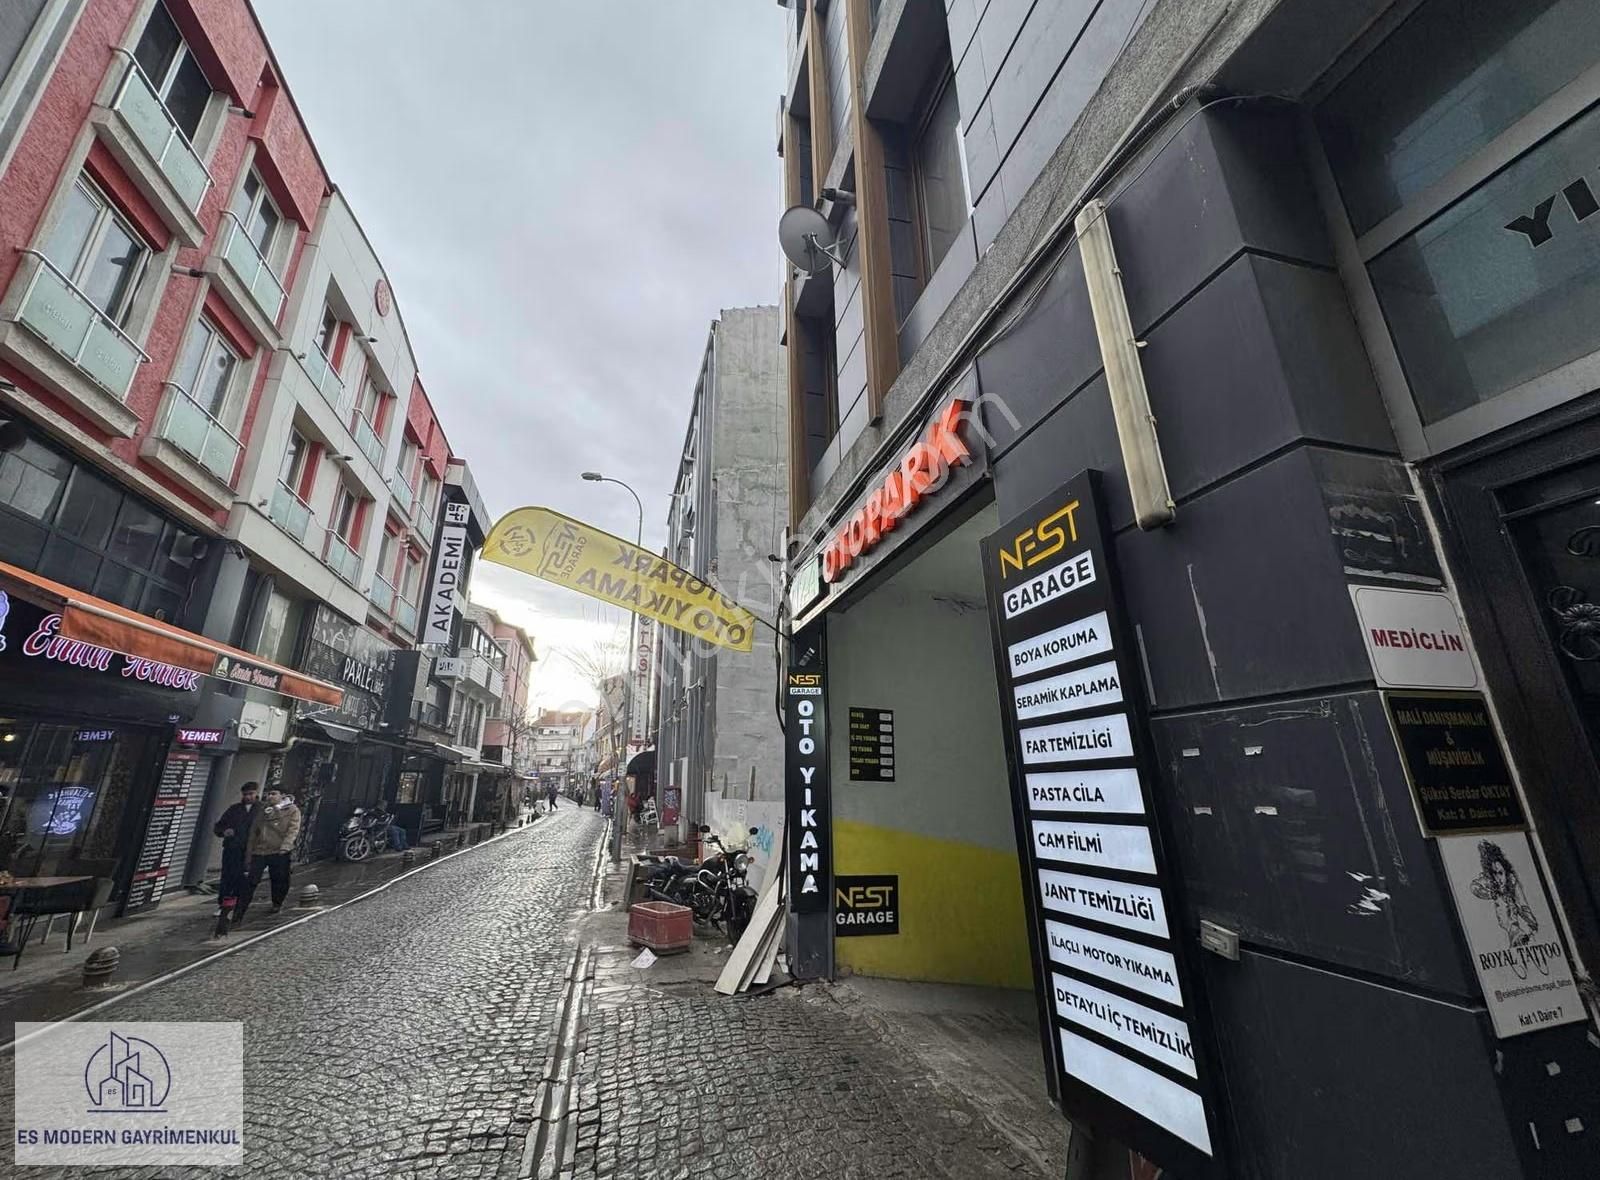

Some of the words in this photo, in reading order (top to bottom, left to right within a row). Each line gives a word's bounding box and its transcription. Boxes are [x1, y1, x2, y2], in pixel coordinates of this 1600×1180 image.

[1504, 165, 1600, 248] YI
[823, 399, 974, 584] OTOPARK
[1000, 500, 1080, 579] NEST
[432, 536, 462, 632] AKADEMİ
[1006, 557, 1092, 614] GARAGE
[1014, 643, 1043, 666] BOYA
[1043, 627, 1098, 656] KORUMA
[1371, 627, 1464, 652] MEDİCLİN
[789, 674, 822, 686] NEST
[1016, 687, 1059, 709] SERAMİK
[1059, 676, 1120, 700] KAPLAMA
[180, 729, 220, 742] YEMEK
[798, 700, 815, 755] OTO
[1026, 739, 1048, 754] FAR
[1032, 787, 1071, 802] PASTA
[1073, 782, 1105, 802] CİLA
[800, 766, 819, 894] YIKAMA
[1038, 833, 1065, 849] CAM
[1067, 830, 1103, 854] FİLMİ
[835, 885, 894, 908] NEST
[1045, 882, 1077, 904] JANT
[1079, 889, 1156, 921] TEMİZLİĞİ
[835, 911, 894, 926] GARAGE
[1050, 931, 1080, 955] İLAÇLI
[1083, 944, 1122, 969] MOTOR
[1122, 955, 1175, 986] YIKAMA
[1479, 948, 1517, 971] ROYAL
[1508, 942, 1562, 980] TATTOO
[1056, 988, 1106, 1020] DETAYLI
[1107, 1003, 1122, 1031] İÇ
[1122, 1016, 1195, 1060] TEMİZLİK
[1518, 1012, 1533, 1027] Kat
[1532, 1012, 1538, 1023] 1
[1537, 1009, 1558, 1022] Daire
[1557, 1006, 1563, 1018] 7
